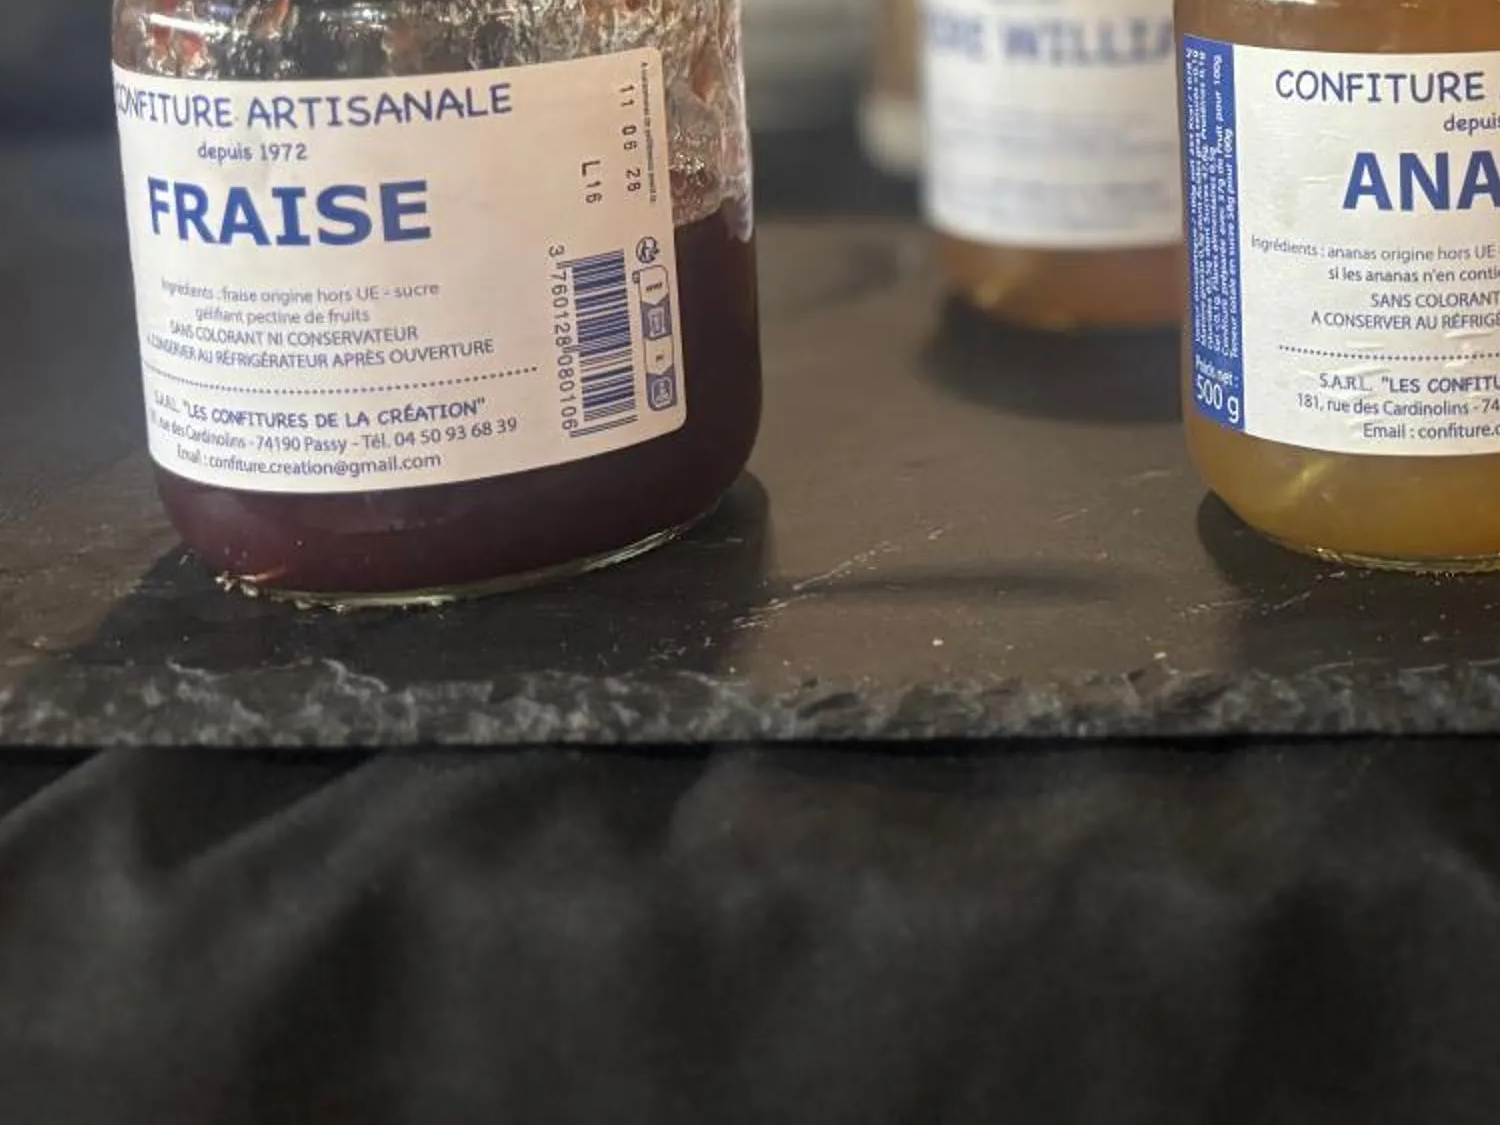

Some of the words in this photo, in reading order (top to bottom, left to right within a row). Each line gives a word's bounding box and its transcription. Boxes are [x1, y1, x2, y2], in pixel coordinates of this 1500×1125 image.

[619, 83, 635, 108] 11
[1275, 69, 1485, 103] CONFITURE
[247, 83, 514, 129] ARTISANALE
[197, 142, 252, 166] depuis
[260, 143, 309, 161] 1972
[147, 176, 432, 247] FRAISE
[1327, 246, 1376, 260] ananas
[1380, 247, 1434, 264] origine
[1437, 244, 1471, 260] hors
[1475, 244, 1496, 259] UE
[1328, 266, 1338, 280] si
[1341, 266, 1362, 281] les
[1365, 269, 1418, 283] ananas
[1423, 268, 1455, 282] n'en
[260, 289, 312, 306] origine
[317, 287, 352, 303] hors
[356, 286, 380, 301] UE
[394, 283, 440, 299] sucre
[1370, 293, 1410, 307] SANS
[1414, 291, 1500, 308] COLORANT
[246, 309, 301, 326] pectine
[303, 310, 324, 324] de
[328, 308, 370, 324] fruits
[1311, 310, 1321, 324] A
[1323, 312, 1410, 329] CONSERVER
[1415, 316, 1437, 330] AU
[195, 326, 266, 347] COLORANT
[267, 332, 283, 346] NI
[287, 326, 419, 347] CONSERVATEUR
[215, 347, 328, 369] RÉFRIGÉRATEUR
[332, 349, 385, 368] APRÈS
[389, 338, 495, 365] OUVERTURE
[1381, 376, 1420, 394] "LES
[1197, 374, 1223, 410] 500
[1227, 396, 1239, 423] g
[1298, 392, 1323, 412] 181,
[1327, 399, 1350, 413] rue
[1353, 398, 1378, 414] des
[1383, 398, 1469, 416] Cardinolins
[211, 407, 309, 429] CONFITURES
[316, 413, 338, 428] DE
[346, 412, 370, 427] LA
[378, 397, 485, 425] CRÉATION"
[257, 435, 301, 453] 74190
[304, 436, 346, 454] Passy
[362, 433, 391, 450] Tél.
[394, 431, 415, 447] 04
[420, 428, 441, 444] 50
[445, 425, 467, 441] 93
[471, 422, 493, 438] 68
[496, 417, 518, 434] 39
[1363, 422, 1405, 438] Email
